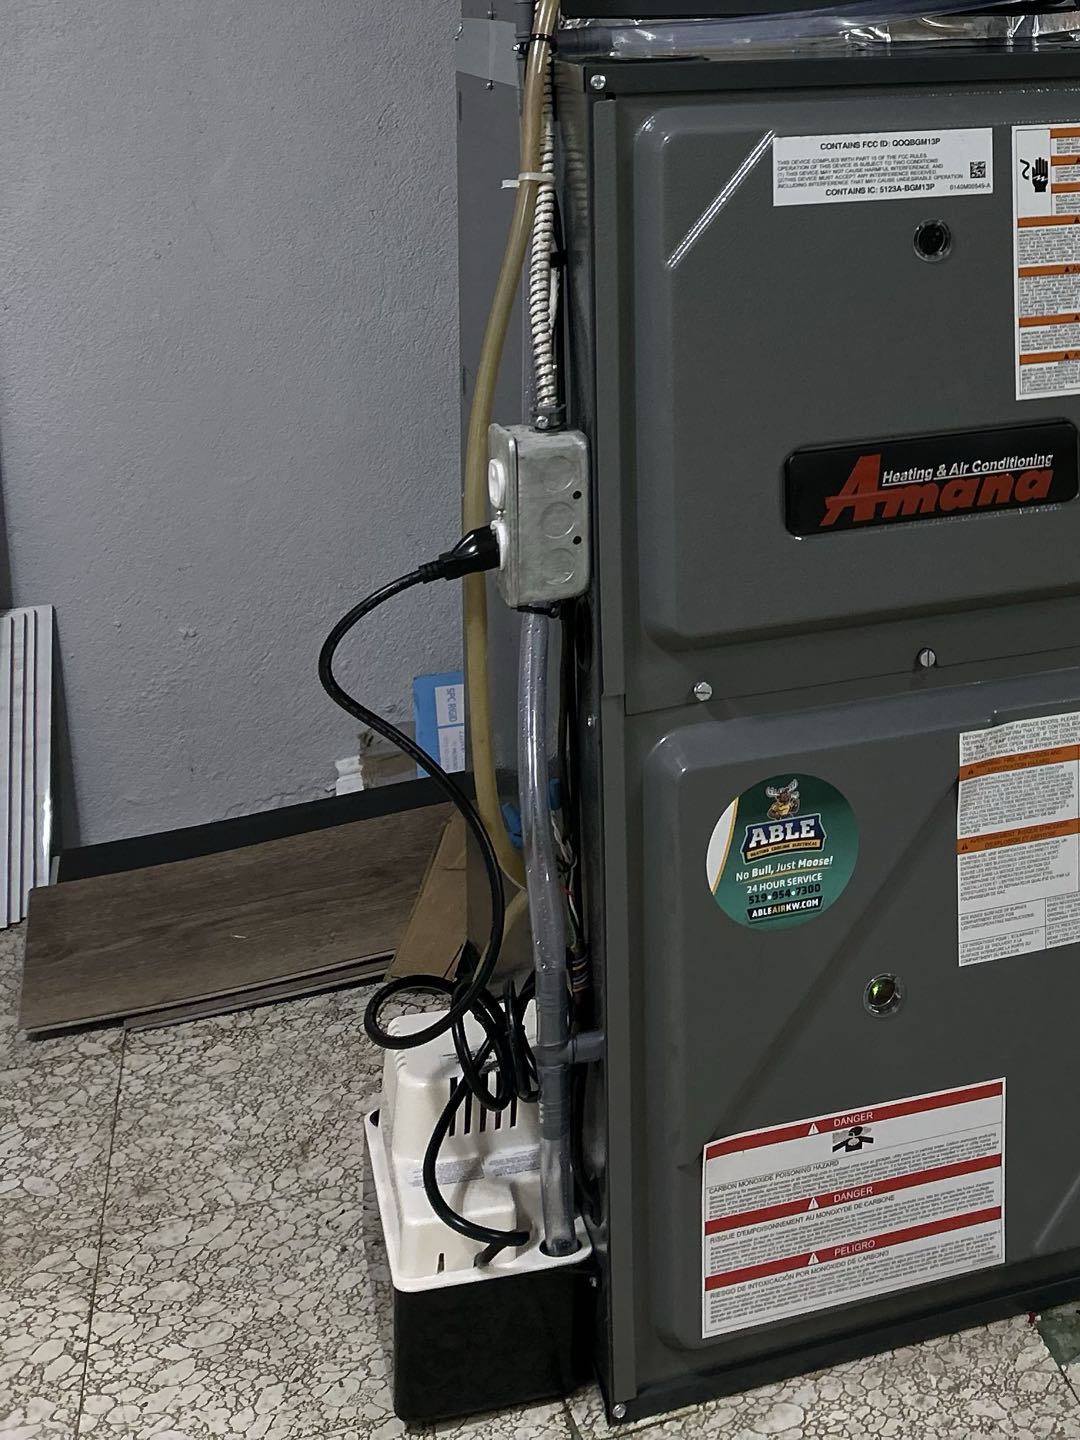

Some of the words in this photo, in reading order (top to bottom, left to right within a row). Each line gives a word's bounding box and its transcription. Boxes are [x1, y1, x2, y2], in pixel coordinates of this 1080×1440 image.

[820, 140, 861, 150] CONTAINS
[862, 139, 879, 149] FCC
[880, 139, 891, 148] ID:
[826, 187, 866, 196] CONTAINS
[879, 184, 935, 193] 5123A-BGM13P
[883, 467, 933, 482] Heating
[936, 464, 947, 476] &
[949, 461, 968, 475] Air
[972, 453, 1053, 473] Conditioning
[819, 454, 1054, 526] Amana
[446, 687, 456, 702] SPC
[750, 819, 815, 848] ABLE
[736, 871, 749, 882] No
[752, 866, 774, 877] Bull,
[776, 862, 796, 872] Just
[798, 856, 833, 868] Moose!
[747, 885, 757, 893] 24
[759, 879, 785, 890] HOUR
[787, 873, 822, 886] SERVICE
[751, 898, 818, 917] ABLEAIRKW.COM
[834, 1111, 873, 1127] DANGER
[709, 1183, 737, 1194] CARBON
[739, 1176, 773, 1188] MONOXIDE
[775, 1167, 811, 1180] POISONING
[813, 1160, 839, 1171] HAZARD
[833, 1187, 873, 1203] DANGER
[710, 1233, 735, 1244] RISQUE
[737, 1217, 804, 1237] D'EMPOISONNEMENT
[816, 1206, 852, 1218] MONOXYDE
[864, 1195, 895, 1207] CARBONE
[834, 1240, 875, 1256] PELIGRO
[710, 1289, 736, 1299] RIESGO
[795, 1271, 809, 1279] POR
[847, 1258, 856, 1266] DE
[857, 1250, 889, 1262] CARBONO
